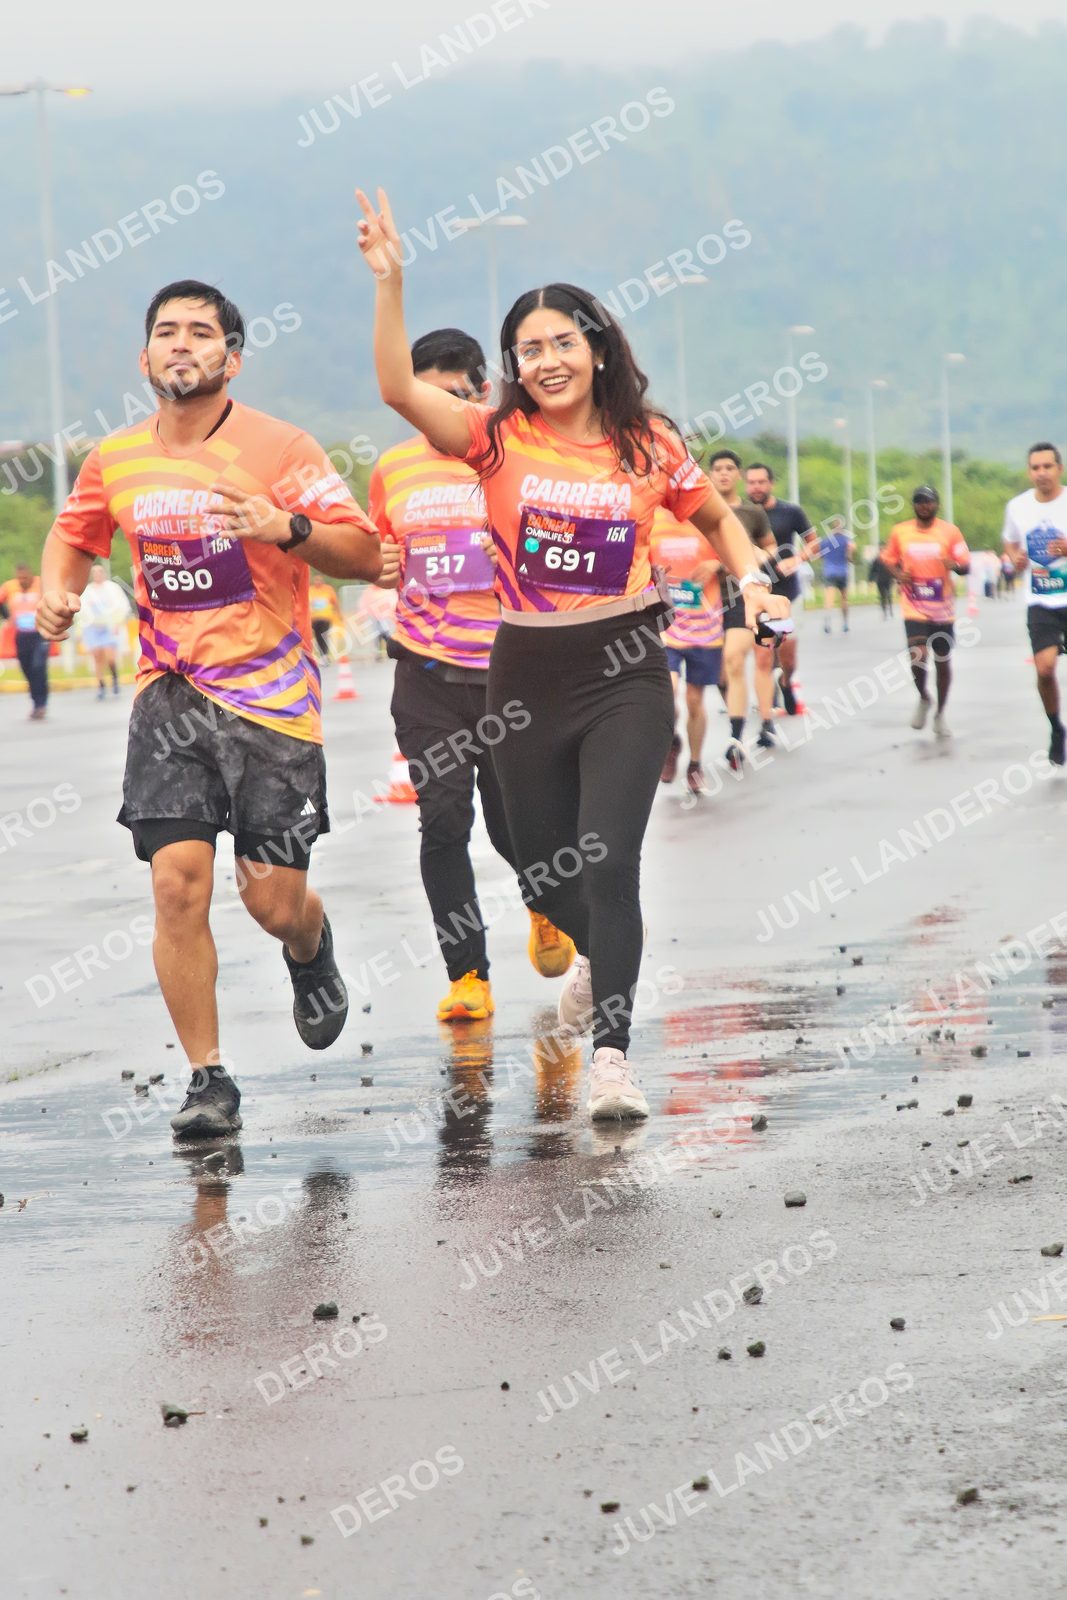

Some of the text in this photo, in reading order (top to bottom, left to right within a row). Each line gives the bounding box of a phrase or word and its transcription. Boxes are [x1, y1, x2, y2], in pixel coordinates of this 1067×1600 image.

[521, 474, 631, 506] CARRERA
[527, 513, 576, 534] CARRERA
[143, 541, 181, 557] CARRERA
[544, 546, 596, 573] 691
[426, 555, 465, 575] 517
[163, 569, 213, 591] 690
